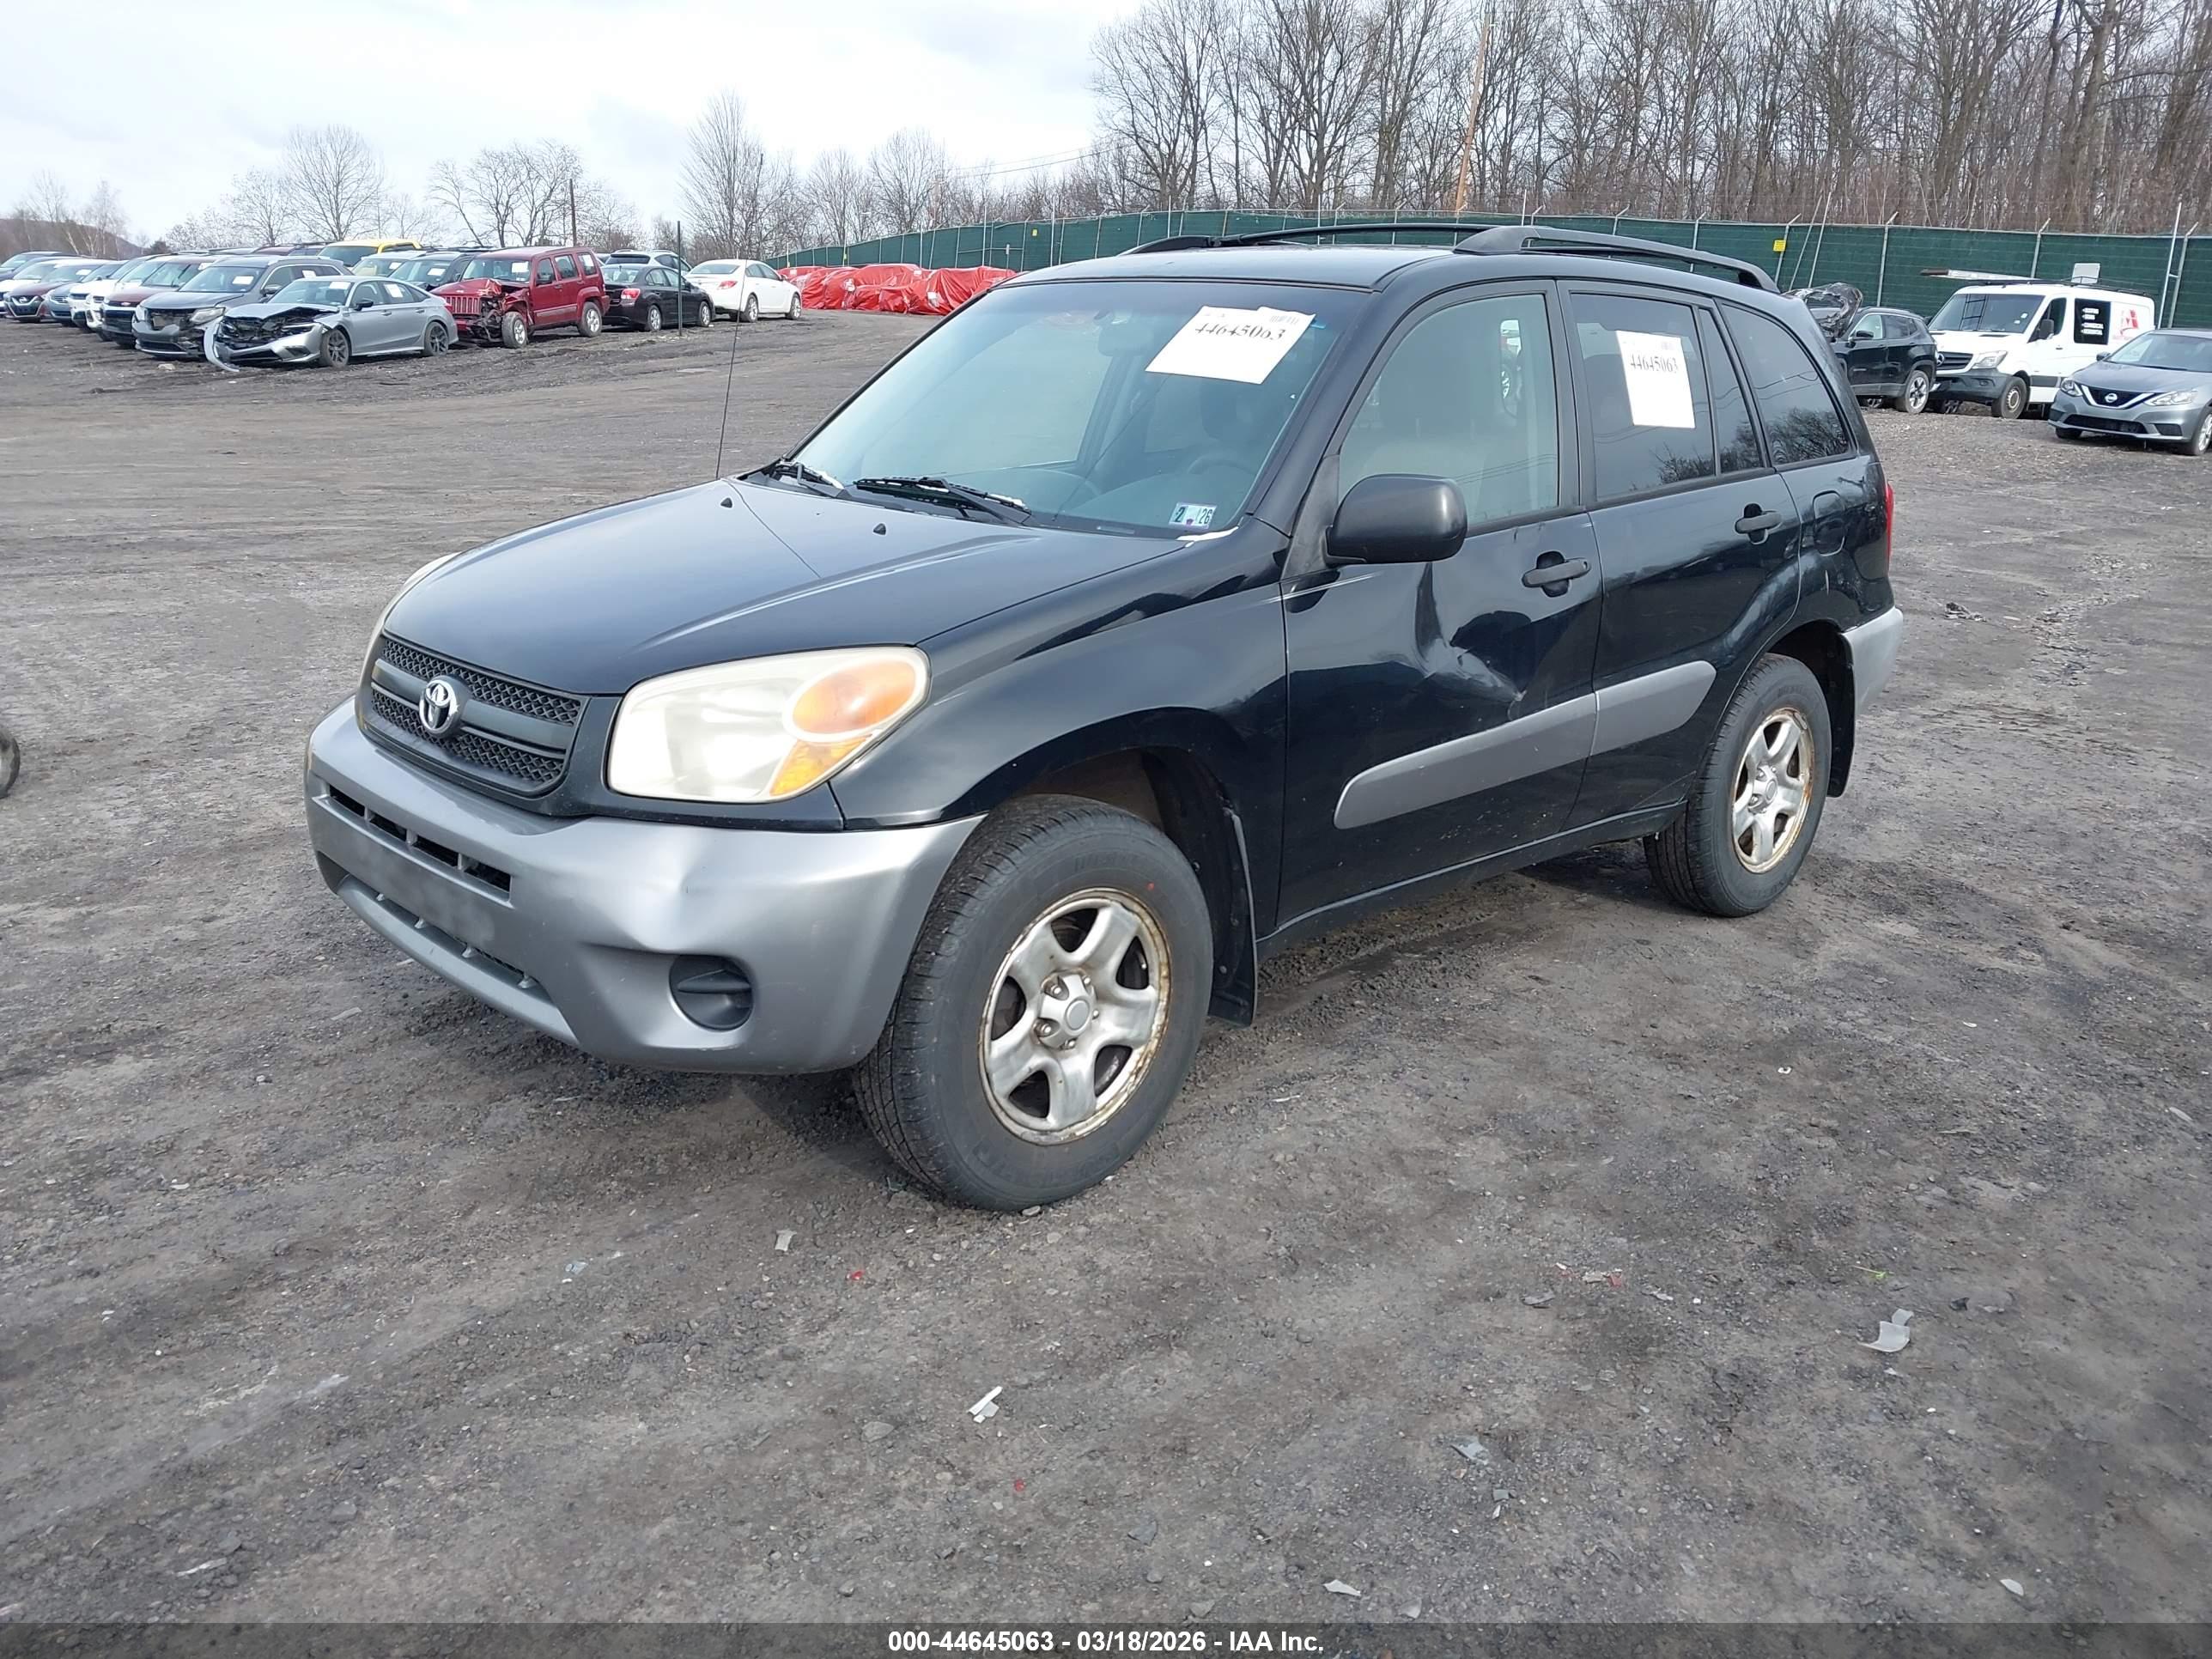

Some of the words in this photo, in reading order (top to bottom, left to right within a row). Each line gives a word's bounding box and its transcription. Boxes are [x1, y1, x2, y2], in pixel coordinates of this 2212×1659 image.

[1194, 322, 1286, 340] 44645063
[1630, 353, 1678, 374] 44645063
[1174, 506, 1186, 523] 2
[1198, 507, 1212, 525] 26
